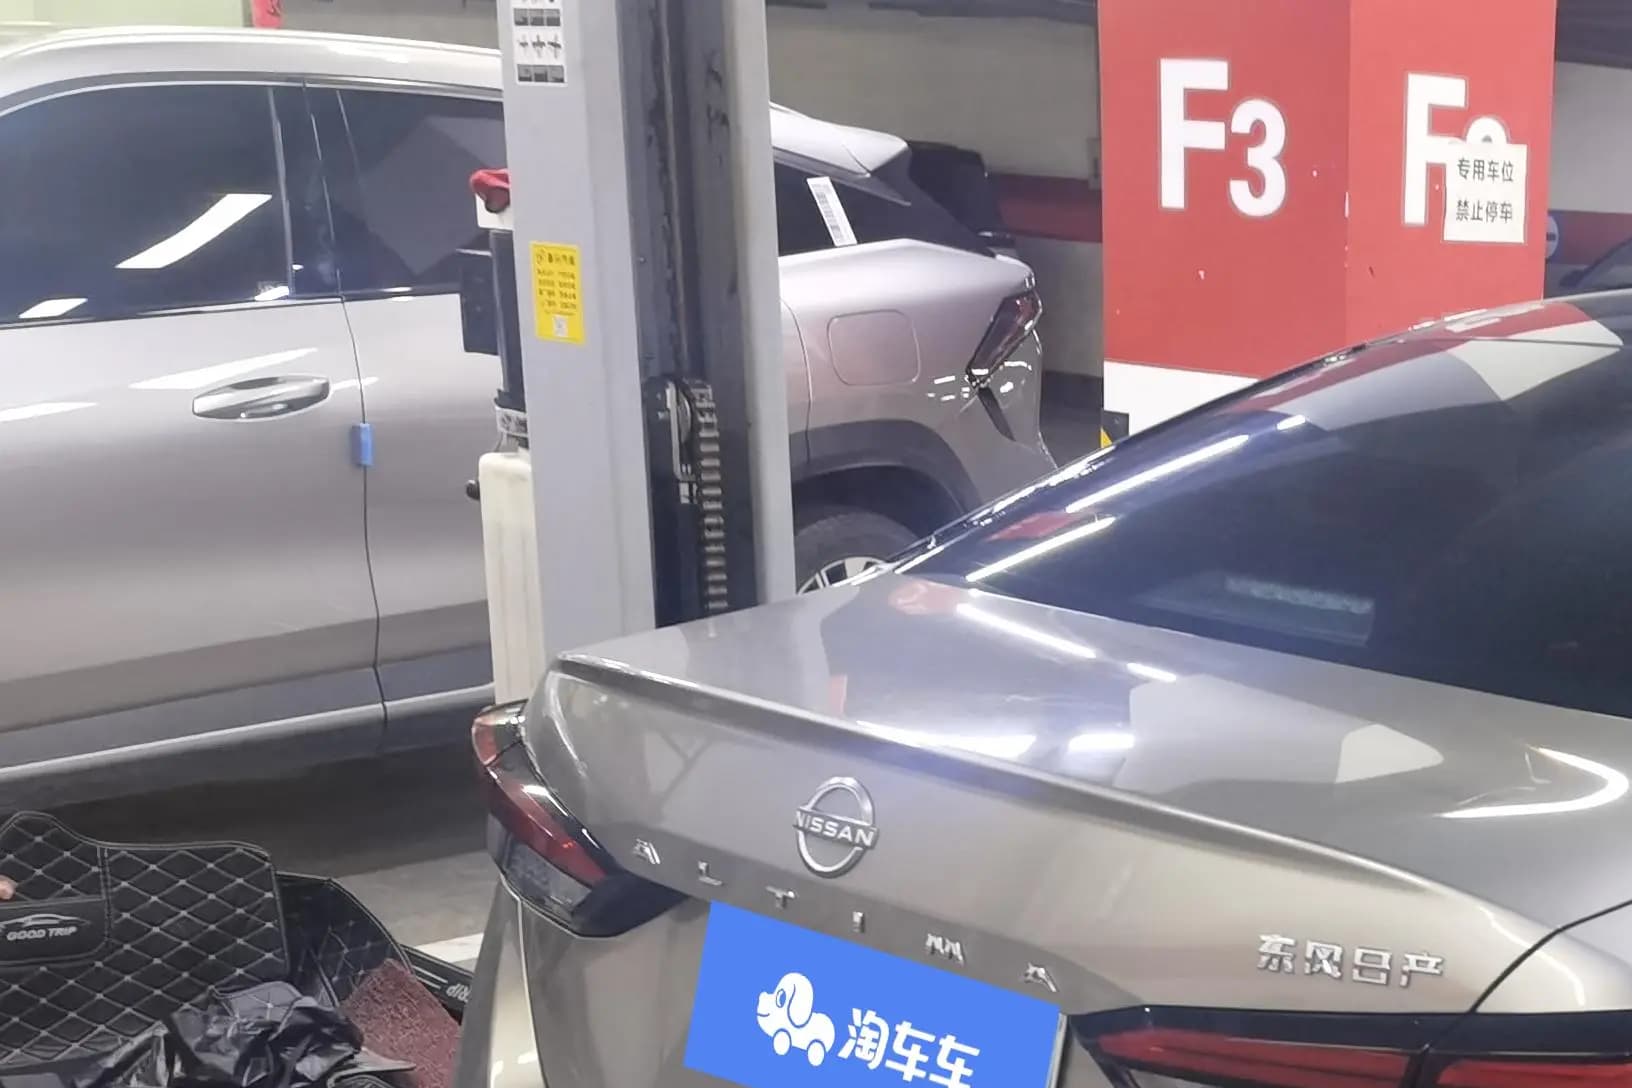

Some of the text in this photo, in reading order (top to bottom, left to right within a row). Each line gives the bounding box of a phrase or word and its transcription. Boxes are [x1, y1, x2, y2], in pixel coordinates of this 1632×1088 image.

[1159, 58, 1287, 217] F3
[1456, 157, 1514, 183] 专用车位
[1455, 199, 1513, 224] 禁止停车
[796, 810, 874, 847] NISSAN
[6, 926, 78, 941] GOOD TRIP
[1257, 934, 1444, 988] 东风日产
